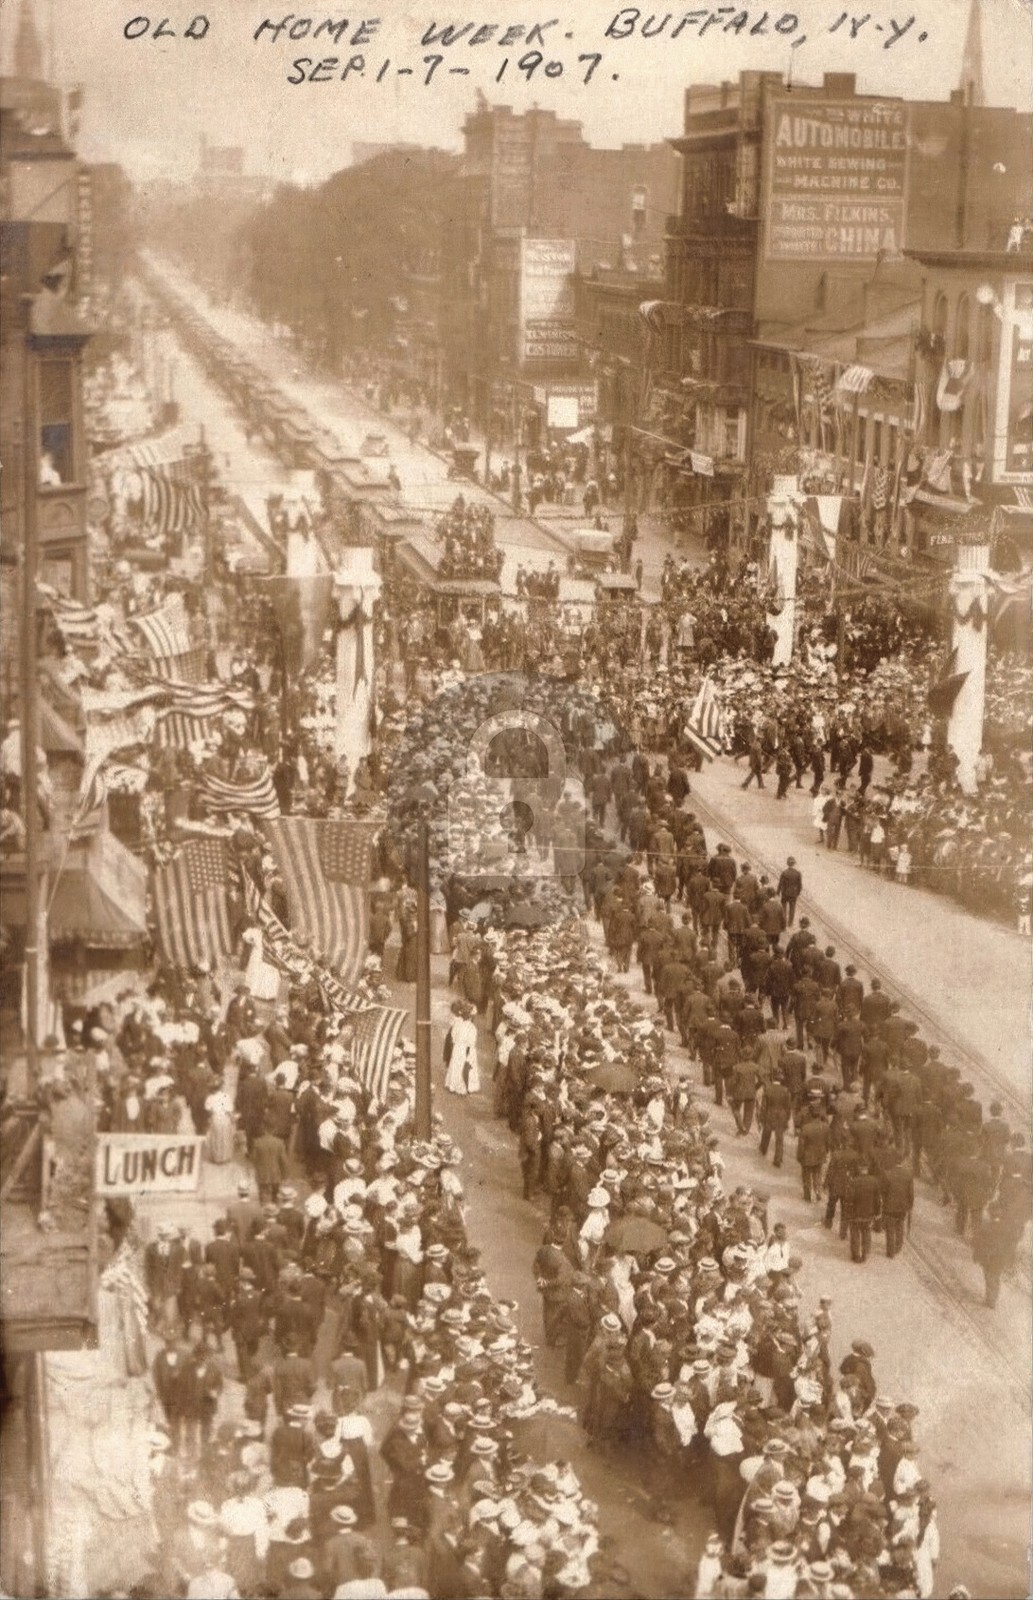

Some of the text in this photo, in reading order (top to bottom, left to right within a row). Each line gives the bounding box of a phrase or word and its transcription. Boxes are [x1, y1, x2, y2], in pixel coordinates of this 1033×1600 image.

[776, 156, 887, 170] WHITE SEWING
[793, 174, 871, 189] MACHINE
[824, 226, 902, 257] CHINA
[103, 1144, 196, 1186] LUNCH
